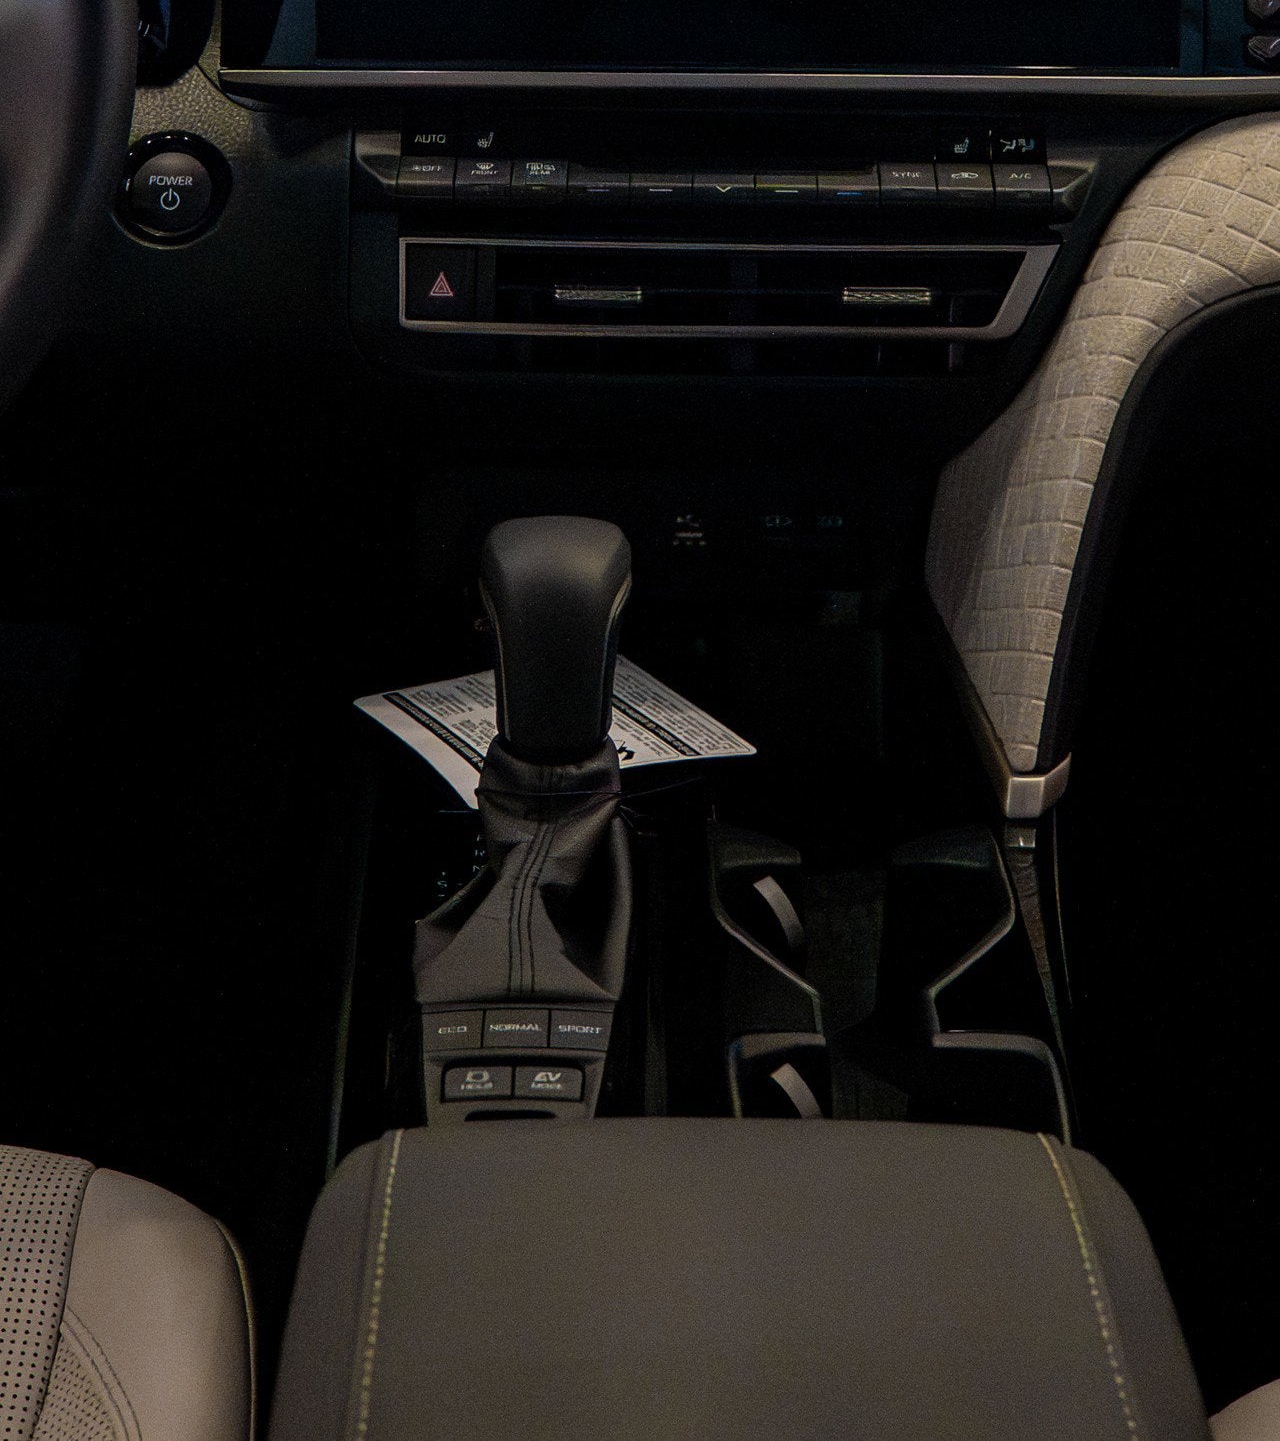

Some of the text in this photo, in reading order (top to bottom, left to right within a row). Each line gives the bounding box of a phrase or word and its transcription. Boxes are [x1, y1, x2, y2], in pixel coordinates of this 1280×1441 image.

[414, 134, 446, 144] AUTO
[148, 175, 193, 186] POWER
[1008, 172, 1032, 180] A/C
[489, 1022, 542, 1032] NORMAL
[558, 1024, 603, 1035] SPORT
[534, 1071, 562, 1082] EV
